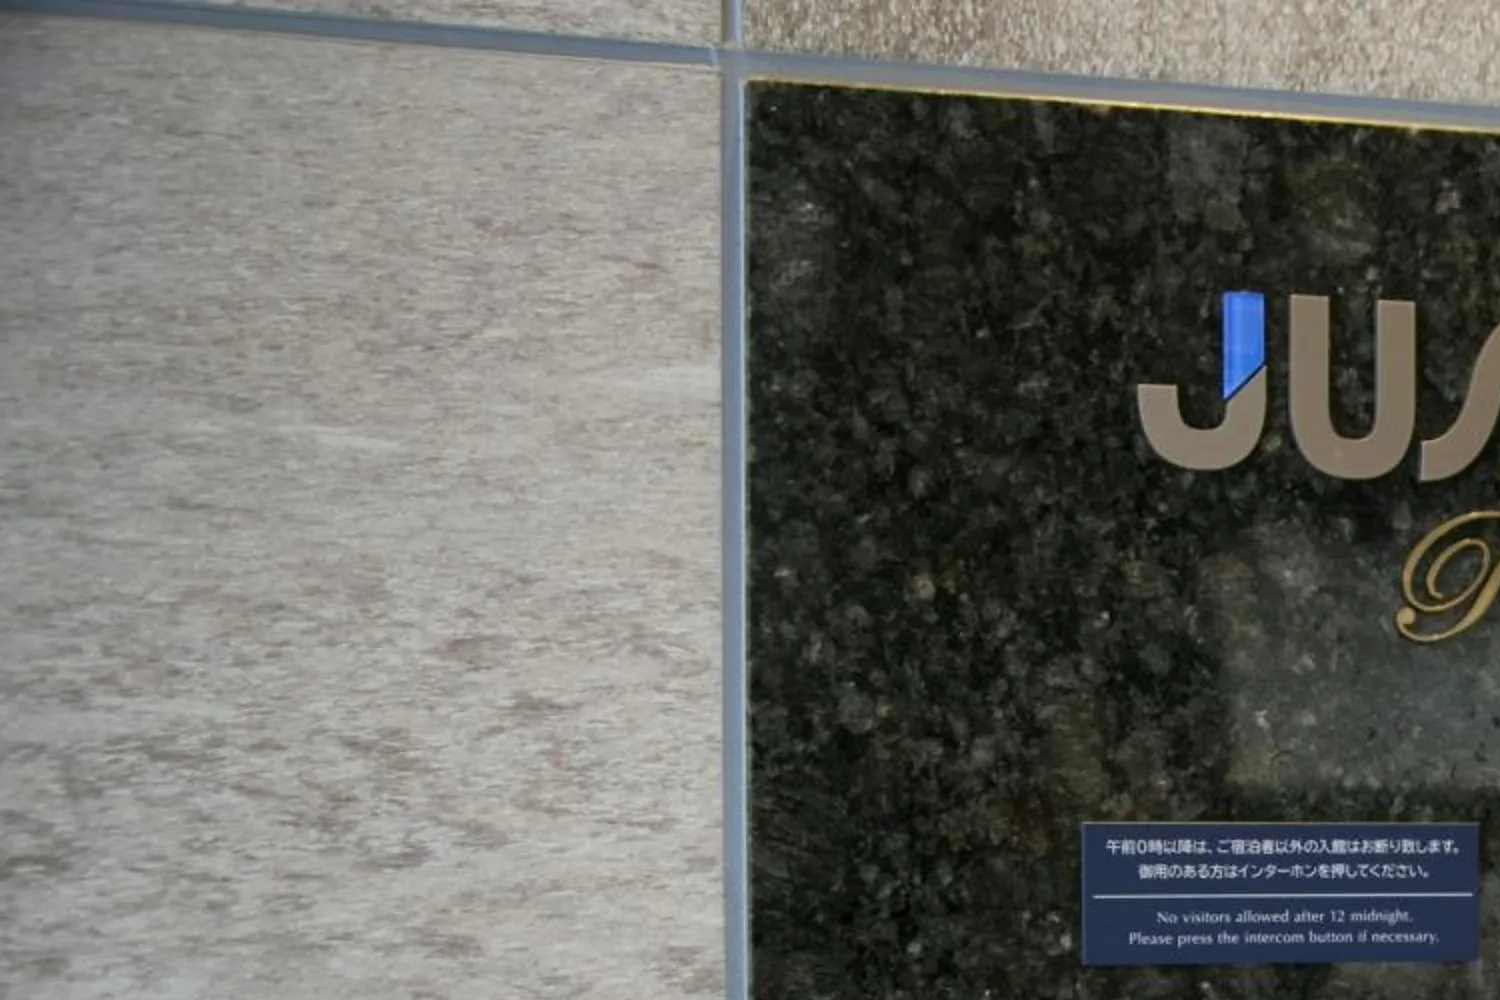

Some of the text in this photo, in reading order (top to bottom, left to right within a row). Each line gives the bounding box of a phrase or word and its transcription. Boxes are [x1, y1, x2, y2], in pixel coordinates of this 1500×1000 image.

[1157, 909, 1414, 926] No visitors allowed after 12 midnight.
[1128, 930, 1440, 948] Please press the intercom button if necessary.
